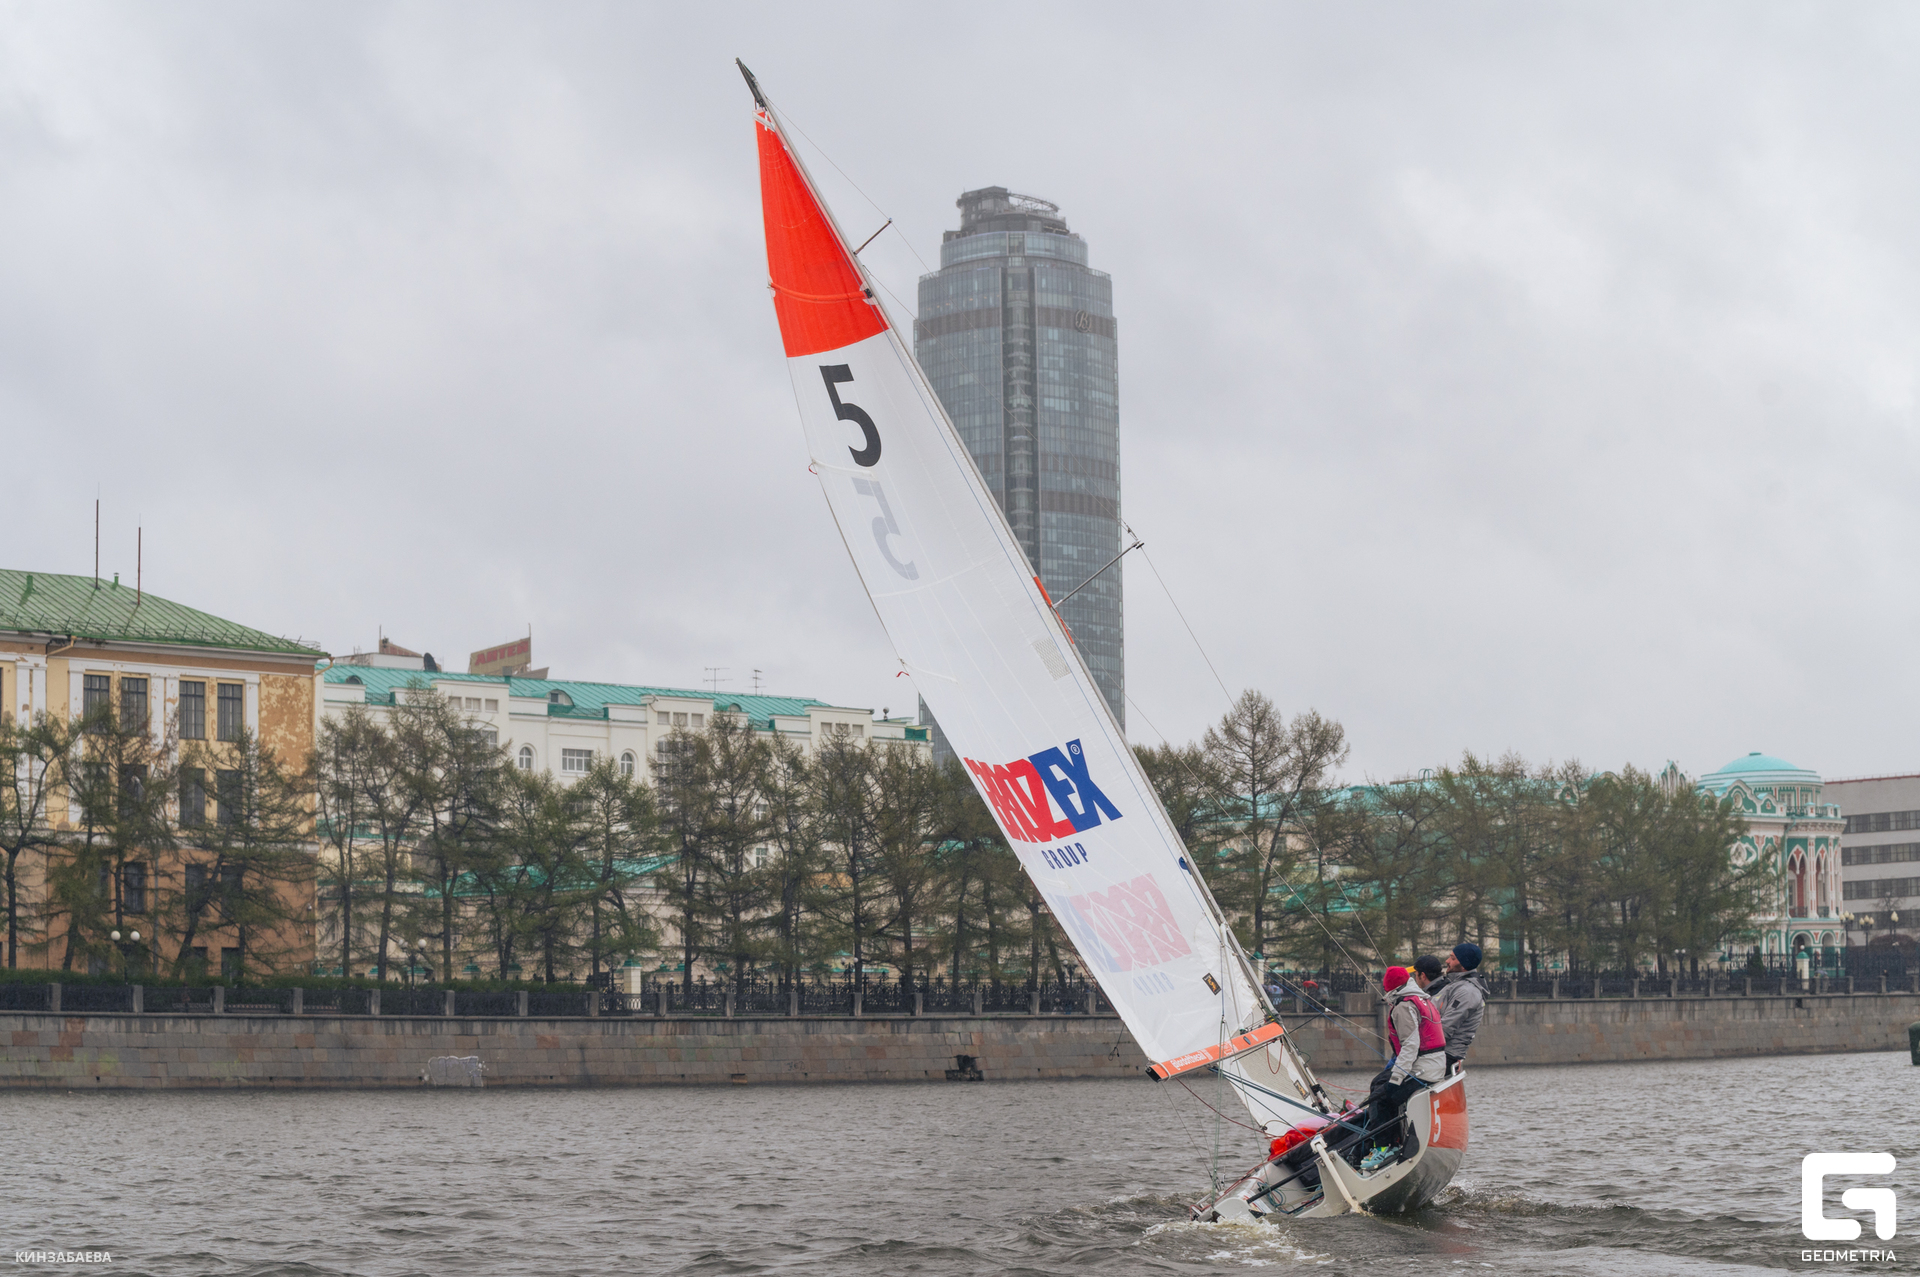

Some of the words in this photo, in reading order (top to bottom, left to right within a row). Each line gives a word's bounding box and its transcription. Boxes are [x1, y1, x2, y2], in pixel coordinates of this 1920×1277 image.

[819, 364, 882, 467] 5
[1041, 842, 1089, 870] GROUP
[1432, 1099, 1442, 1143] 5
